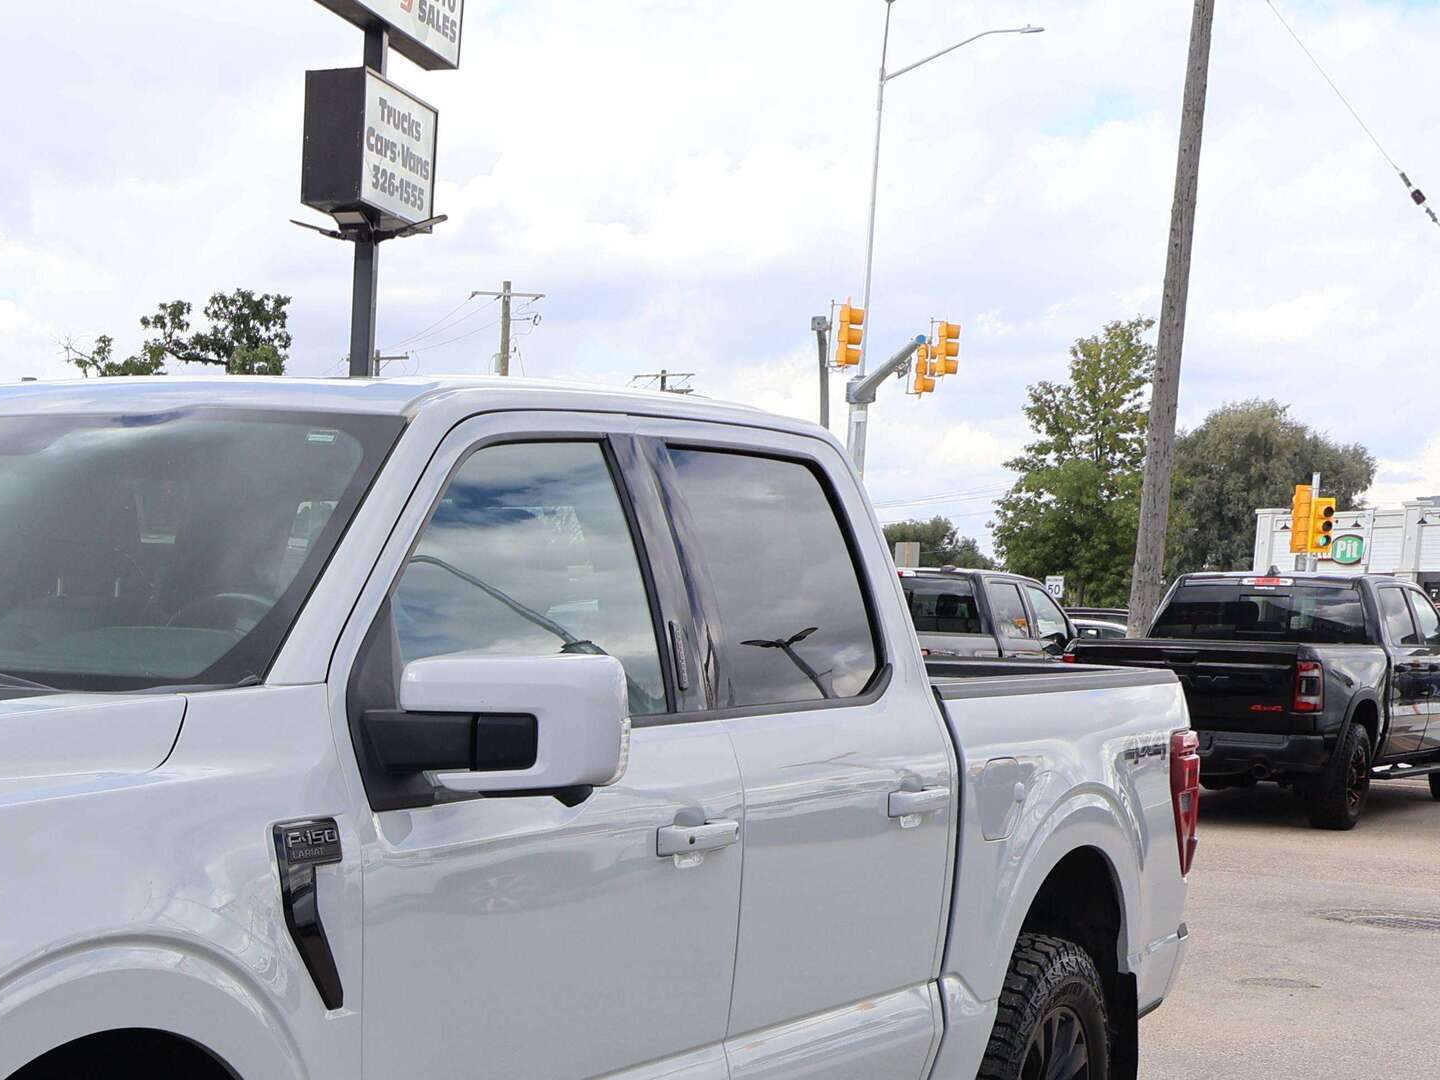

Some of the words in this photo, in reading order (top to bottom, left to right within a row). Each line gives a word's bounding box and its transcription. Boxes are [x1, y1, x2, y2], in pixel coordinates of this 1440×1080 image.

[418, 0, 457, 44] SALES
[379, 97, 422, 142] Trucks
[1335, 540, 1359, 558] Pit
[1047, 584, 1061, 595] 50
[288, 829, 338, 848] F-150
